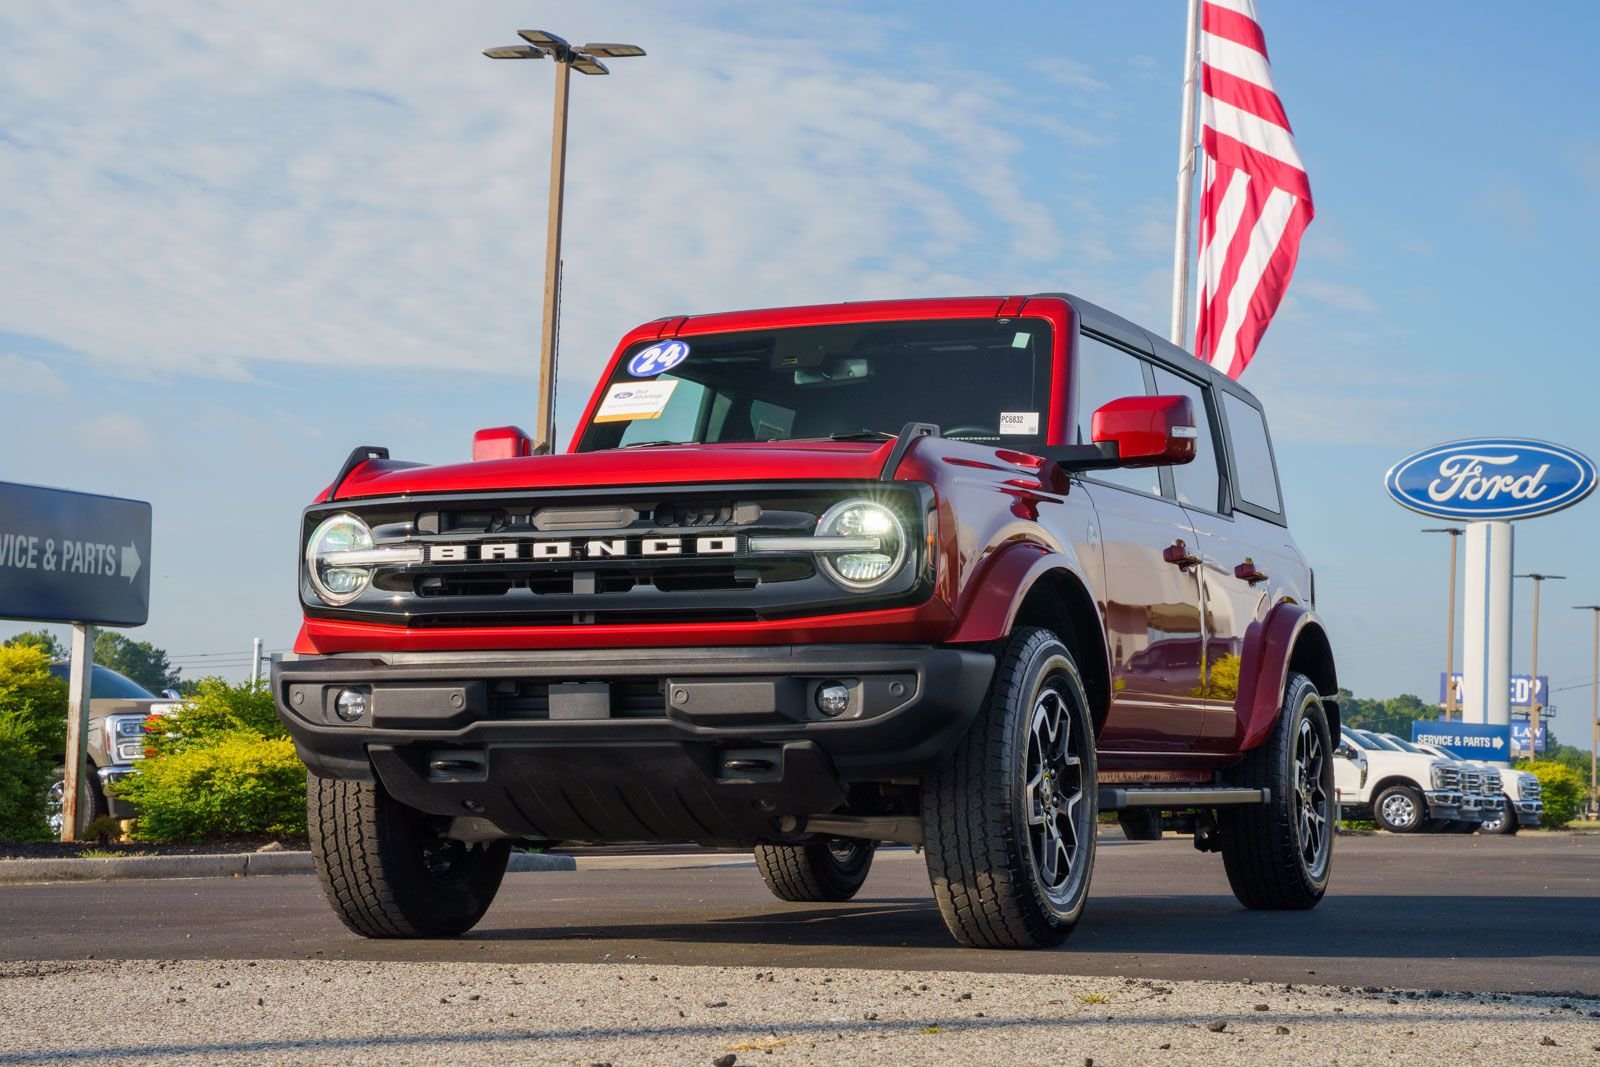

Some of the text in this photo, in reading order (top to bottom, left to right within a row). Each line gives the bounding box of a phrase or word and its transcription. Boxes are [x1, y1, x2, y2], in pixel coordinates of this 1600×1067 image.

[637, 343, 682, 374] 24
[1001, 415, 1024, 424] PC6832
[1428, 454, 1550, 502] Ford
[42, 538, 57, 571] &
[61, 540, 116, 576] PARTS
[430, 536, 737, 562] BRONCO
[1417, 734, 1491, 748] SERVICE & PARTS
[1512, 726, 1543, 738] LAW
